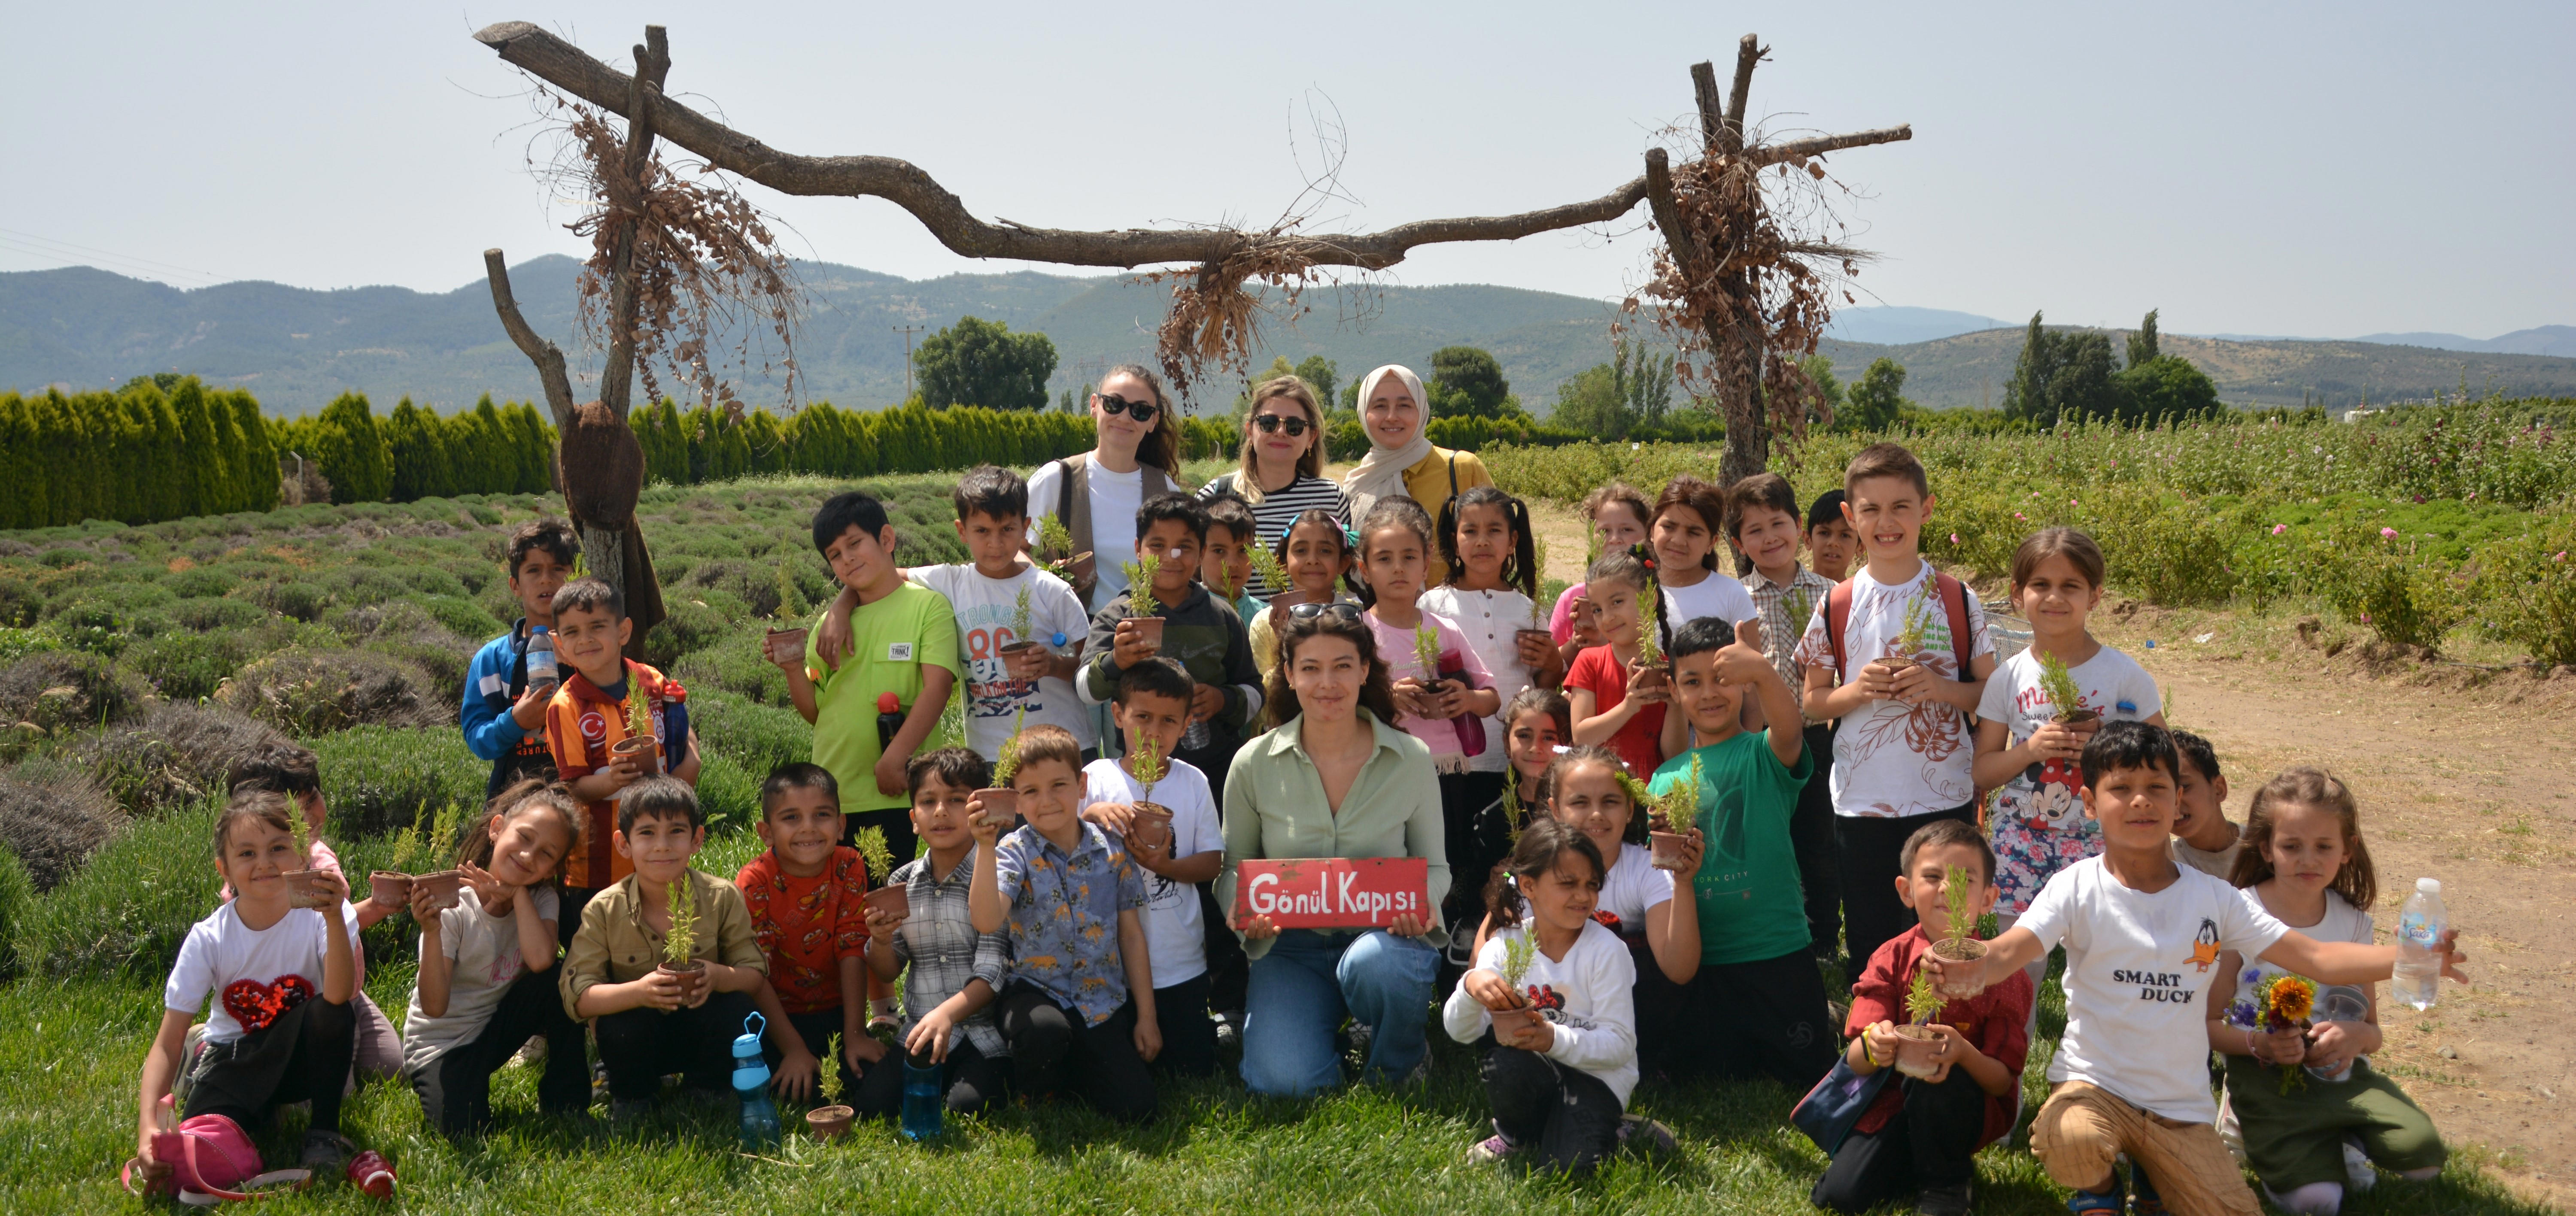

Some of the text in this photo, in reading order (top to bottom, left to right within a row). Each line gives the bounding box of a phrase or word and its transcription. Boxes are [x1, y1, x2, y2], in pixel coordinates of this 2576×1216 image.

[969, 677, 1028, 697] WALK ON THE
[2022, 711, 2054, 721] Sweet
[1724, 870, 1748, 881] CITY
[1249, 871, 1416, 923] Gönül Kapısı
[2113, 969, 2181, 986] SMART
[2140, 987, 2194, 1003] DUCK
